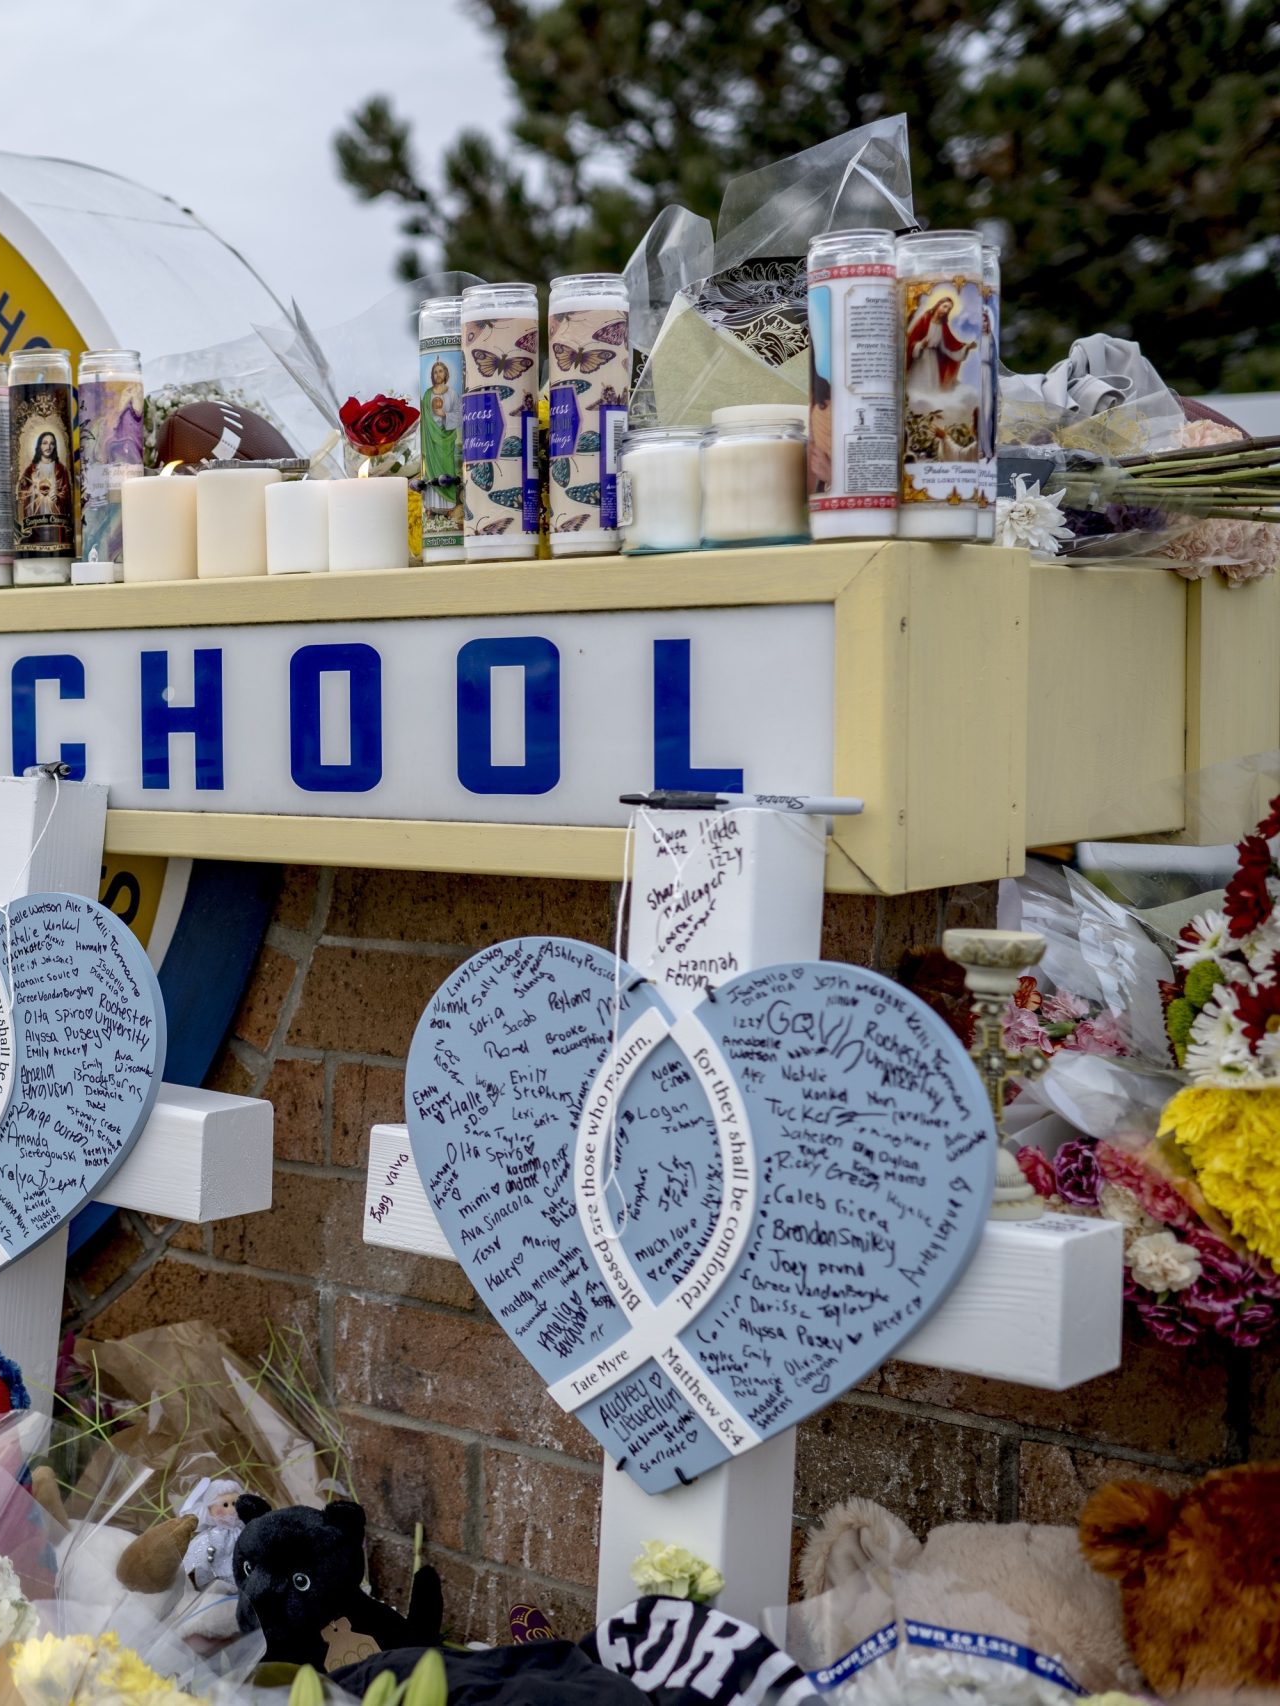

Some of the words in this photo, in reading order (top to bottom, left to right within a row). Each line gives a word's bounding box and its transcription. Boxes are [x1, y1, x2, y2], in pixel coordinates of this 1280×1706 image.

[653, 828, 688, 844] Owen
[28, 903, 61, 917] Watson
[93, 912, 111, 937] Kelli
[545, 941, 584, 968] Ashley
[678, 952, 738, 975] Hannah
[99, 993, 153, 1028] Rochester
[548, 990, 584, 1012] Peyton
[24, 1009, 49, 1024] Olta
[55, 1008, 86, 1023] Spiro
[469, 1007, 505, 1036] Sofia
[502, 1010, 537, 1035] Jacob
[0, 1019, 11, 1057] shall
[25, 1029, 59, 1043] Alyssa
[64, 1027, 104, 1049] Pusey
[545, 1024, 587, 1045] Brooke
[114, 1051, 133, 1061] Ava
[692, 1047, 717, 1077] for
[449, 1091, 481, 1120] Halle
[512, 1106, 534, 1121] Lexi
[587, 1095, 608, 1134] who
[638, 1102, 690, 1122] Logan
[713, 1078, 740, 1126] they
[7, 1121, 49, 1148] Amanda
[447, 1142, 480, 1164] Olta
[486, 1147, 523, 1168] Spiro
[729, 1130, 748, 1180] shall
[580, 1142, 596, 1198] those
[458, 1188, 491, 1219] mimi
[732, 1183, 749, 1212] be
[773, 1183, 827, 1210] Caleb
[460, 1226, 485, 1246] Ava
[483, 1194, 533, 1231] Sinacola
[635, 1237, 669, 1263] much
[669, 1218, 697, 1244] love
[657, 1241, 691, 1276] emma
[677, 1216, 748, 1310] comforted.
[769, 1249, 808, 1279] Joey
[593, 1238, 642, 1312] Blessed
[500, 1290, 536, 1318] maddy
[739, 1318, 787, 1343] Alyssa
[569, 1370, 598, 1396] Tate
[598, 1349, 629, 1382] Myre
[661, 1345, 721, 1419] Matthew
[717, 1417, 746, 1448] 5:4
[907, 1625, 947, 1641] own
[951, 1633, 972, 1645] to
[976, 1635, 1019, 1657] Last
[816, 1650, 860, 1683] Grown
[860, 1639, 876, 1656] to
